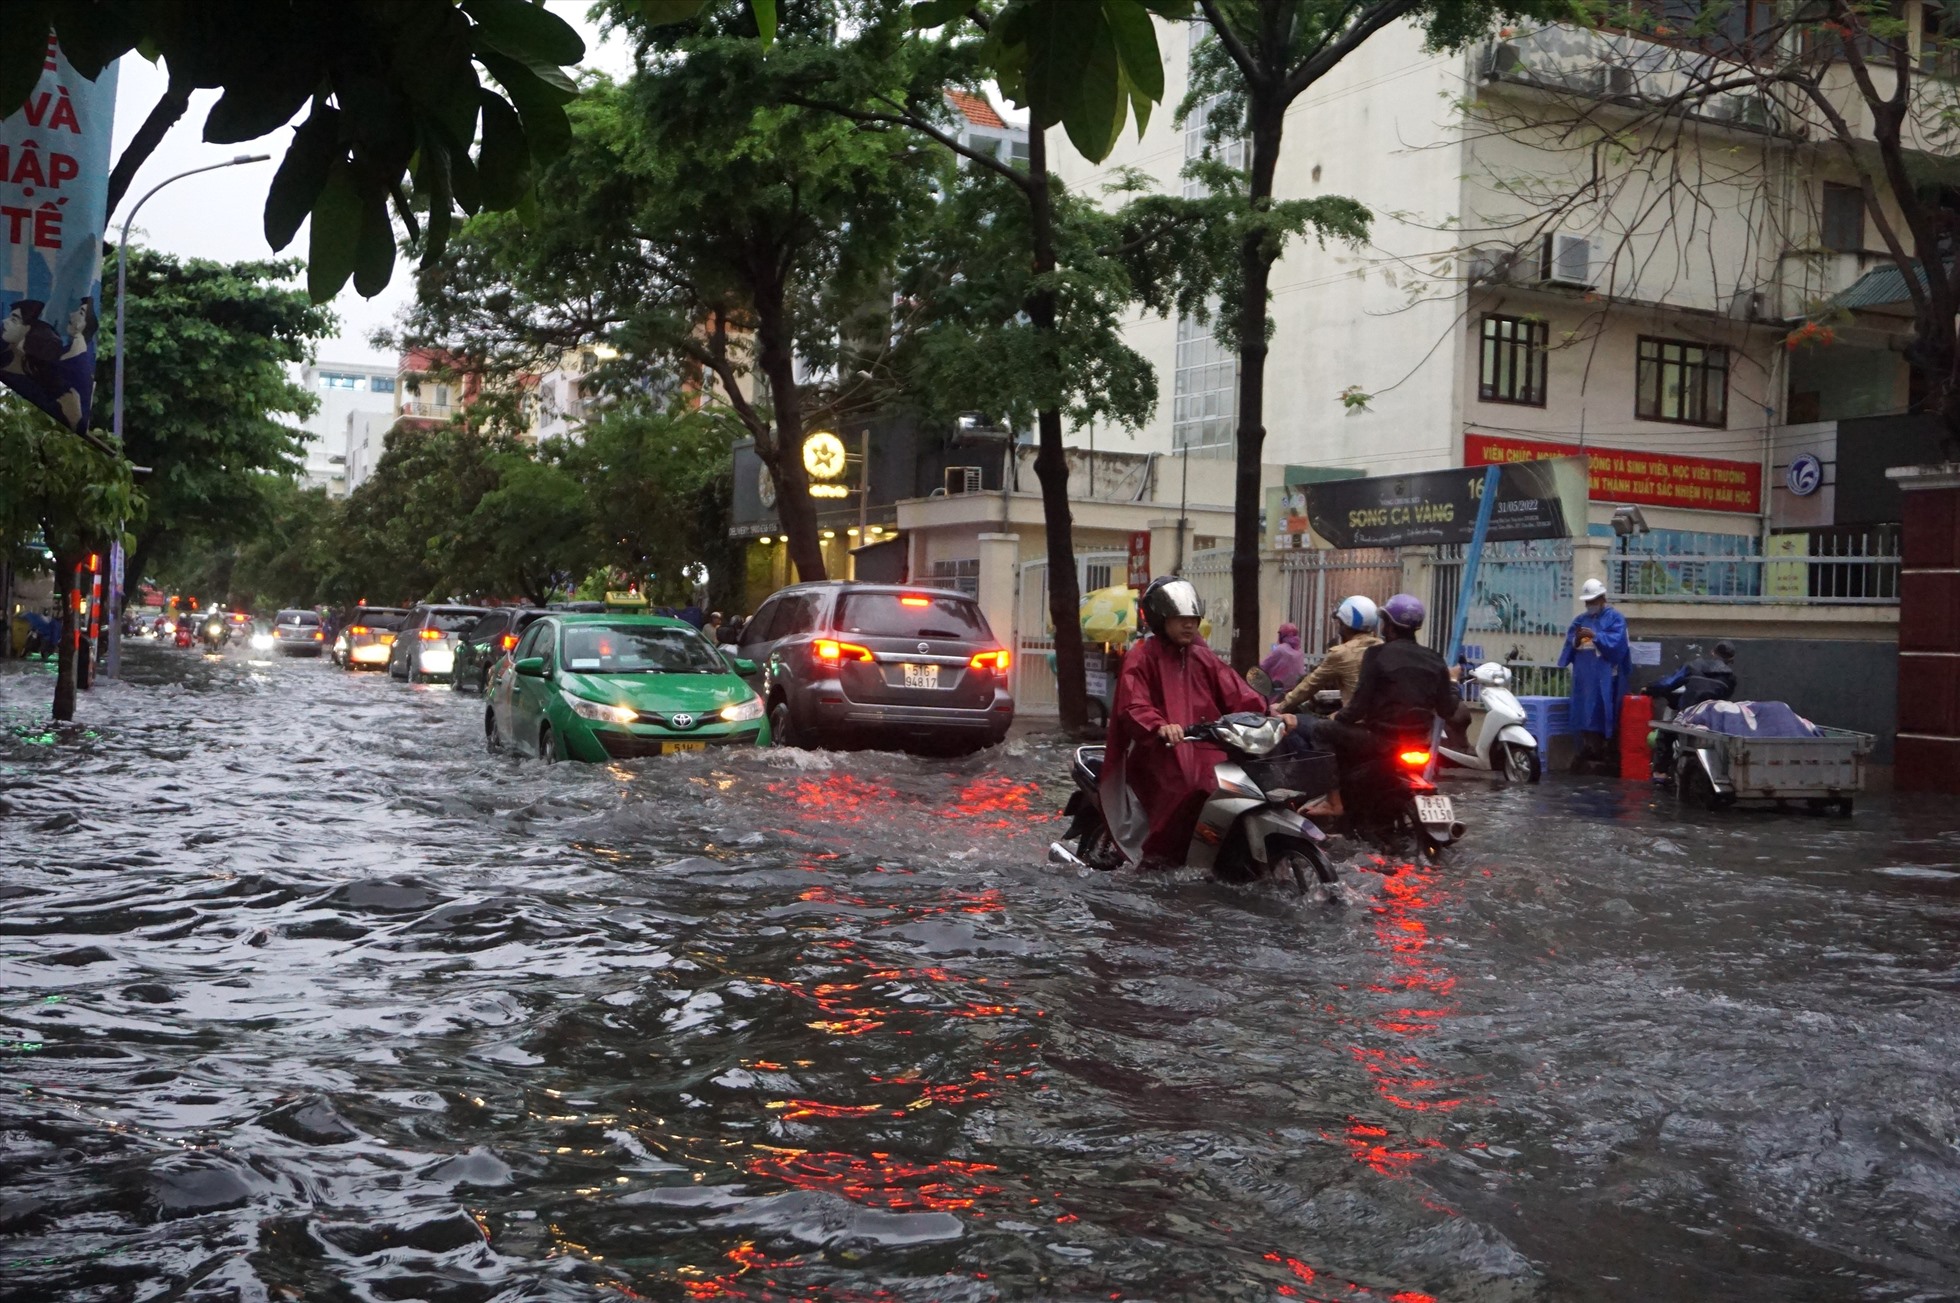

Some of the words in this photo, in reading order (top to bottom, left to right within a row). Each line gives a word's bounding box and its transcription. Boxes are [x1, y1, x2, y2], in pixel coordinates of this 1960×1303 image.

[24, 85, 81, 135] VÀ
[1, 197, 69, 249] TẾ
[1483, 444, 1504, 462] VIÊN
[1613, 456, 1625, 472] VÀ
[1627, 460, 1647, 474] SINH
[1672, 465, 1689, 481] HỌC
[1691, 464, 1711, 481] VIÊN
[1601, 475, 1631, 492] THÀNH
[1633, 476, 1655, 495] XUẤT
[1656, 478, 1673, 496] SẮC
[1675, 483, 1701, 502] NHIỆM
[1703, 486, 1714, 504] VỤ
[1715, 486, 1733, 502] NĂM
[1735, 489, 1752, 506] HỌC
[1349, 508, 1388, 528] SONG
[1391, 507, 1410, 525] CA
[1414, 500, 1454, 524] VÀNG
[1498, 499, 1538, 513] 31/05/2022
[905, 676, 937, 688] 948.17
[913, 665, 930, 676] 51G
